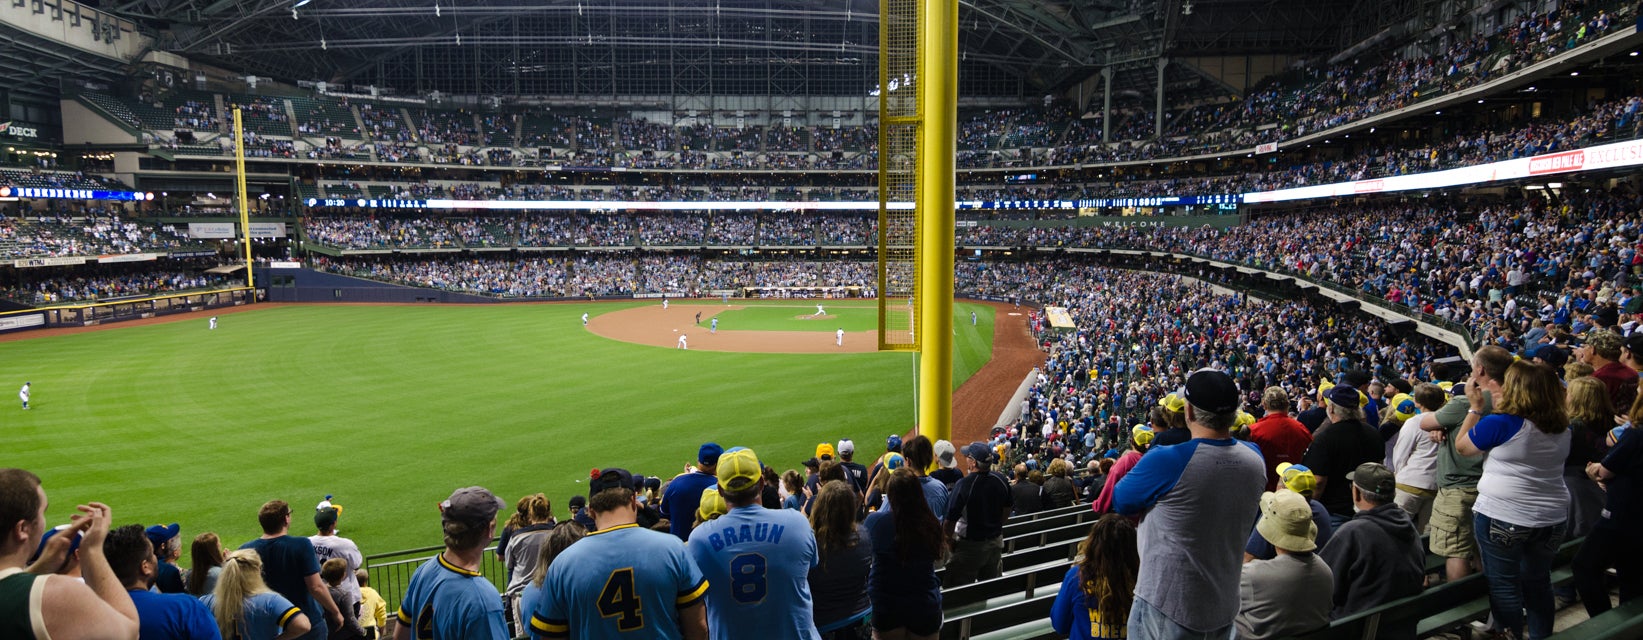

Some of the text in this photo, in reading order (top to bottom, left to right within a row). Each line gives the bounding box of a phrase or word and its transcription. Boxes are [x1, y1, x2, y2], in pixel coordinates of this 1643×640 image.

[9, 126, 38, 138] DECK
[1103, 221, 1166, 229] WELCOME
[708, 522, 785, 552] BRAUN
[730, 551, 769, 605] 8
[596, 566, 645, 632] 4
